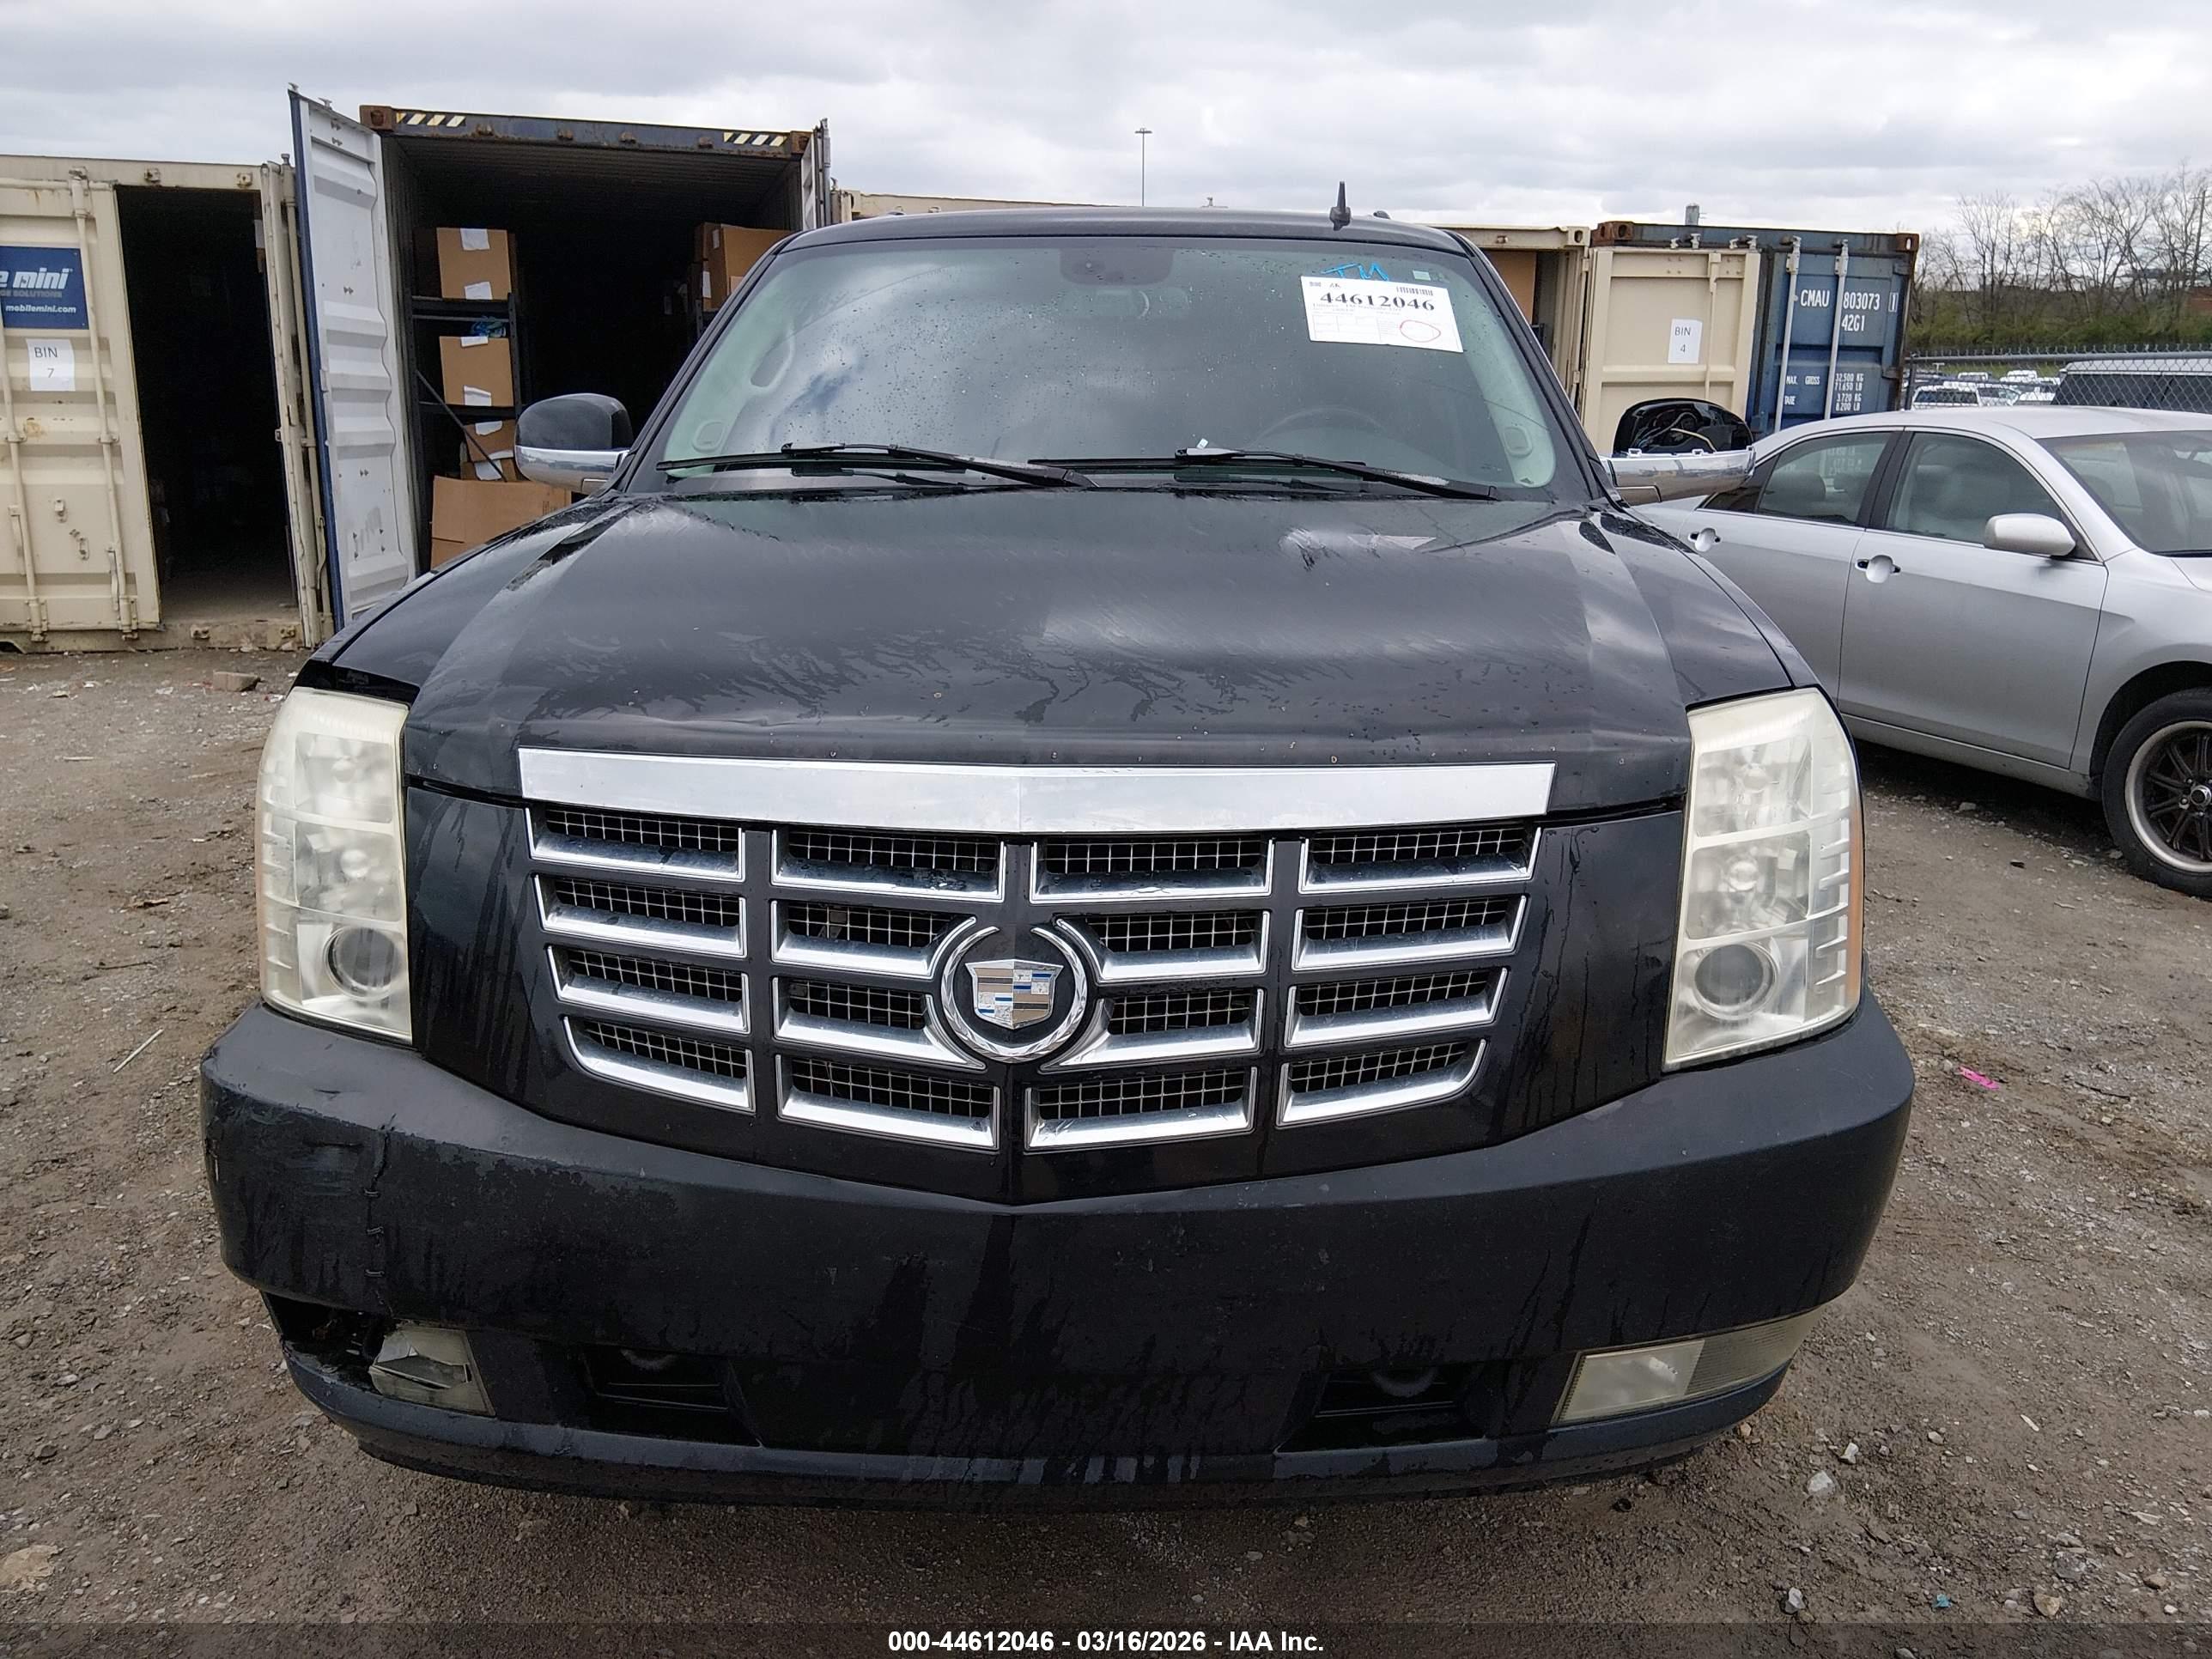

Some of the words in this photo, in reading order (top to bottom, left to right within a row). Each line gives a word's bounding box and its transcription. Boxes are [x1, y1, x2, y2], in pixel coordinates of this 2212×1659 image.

[13, 267, 69, 289] mini
[1320, 292, 1435, 311] 44612046
[1800, 289, 1830, 307] CMAU
[1843, 291, 1881, 310] 803073
[5, 304, 76, 313] mobilemini.com
[1841, 314, 1865, 331] 42G1
[1674, 326, 1691, 336] BIN
[34, 346, 58, 358] BIN
[1680, 343, 1686, 353] 4
[47, 368, 54, 378] 7
